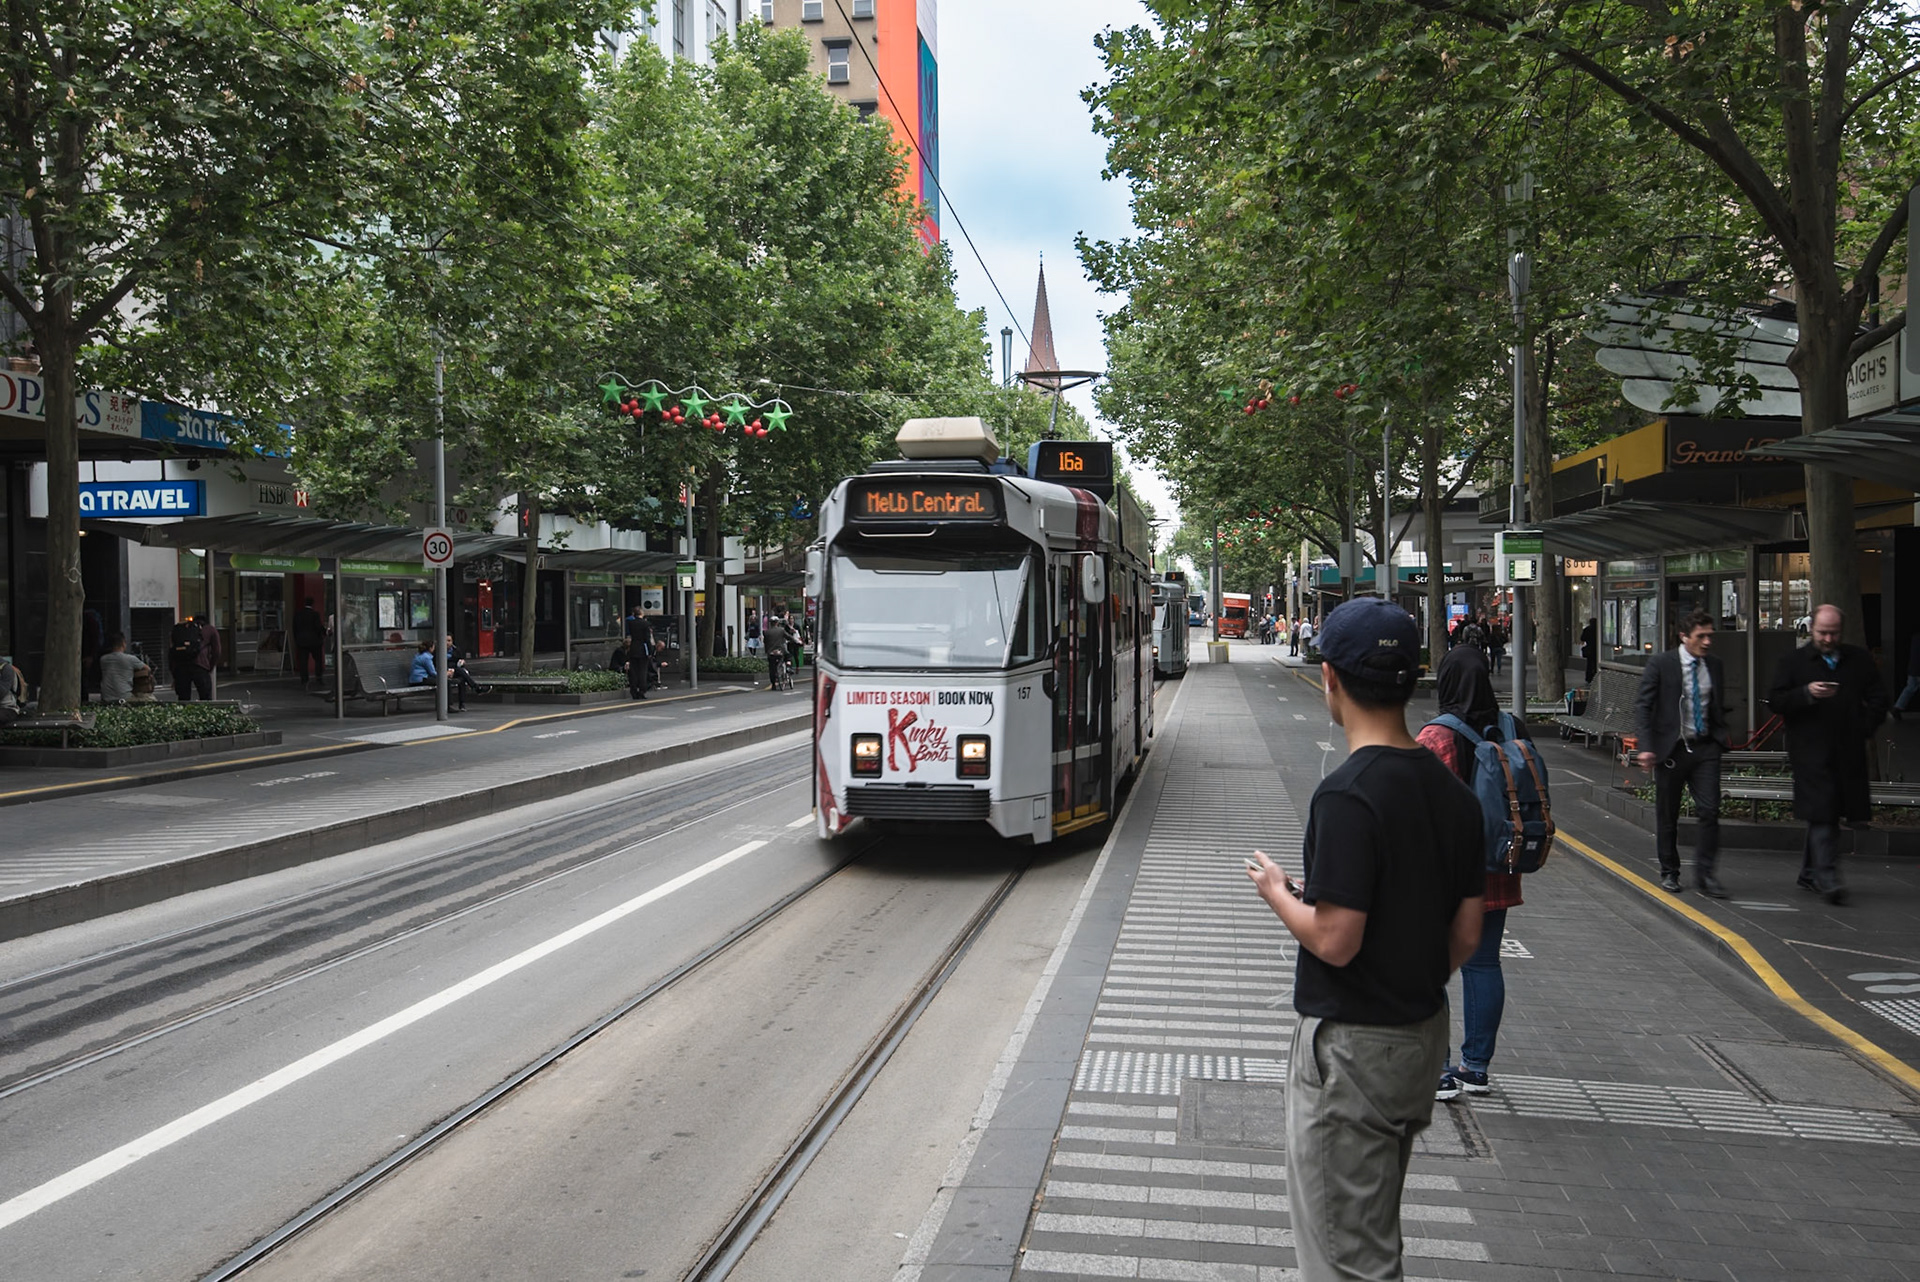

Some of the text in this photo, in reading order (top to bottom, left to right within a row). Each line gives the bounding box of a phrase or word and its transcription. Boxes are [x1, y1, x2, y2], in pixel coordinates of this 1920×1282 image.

[1847, 356, 1887, 387] AIGH'S
[1848, 384, 1880, 400] HOCOLATES
[1058, 451, 1084, 472] 16a
[97, 488, 190, 511] TRAVEL
[259, 484, 291, 506] HSBC
[866, 490, 985, 513] Melb Central
[429, 541, 448, 555] 30
[1379, 639, 1399, 647] POLO
[847, 691, 993, 705] LIMITED SEASON BOOK NOW
[1017, 687, 1031, 699] 157
[887, 708, 949, 773] Kinky
[914, 742, 956, 762] Boots
